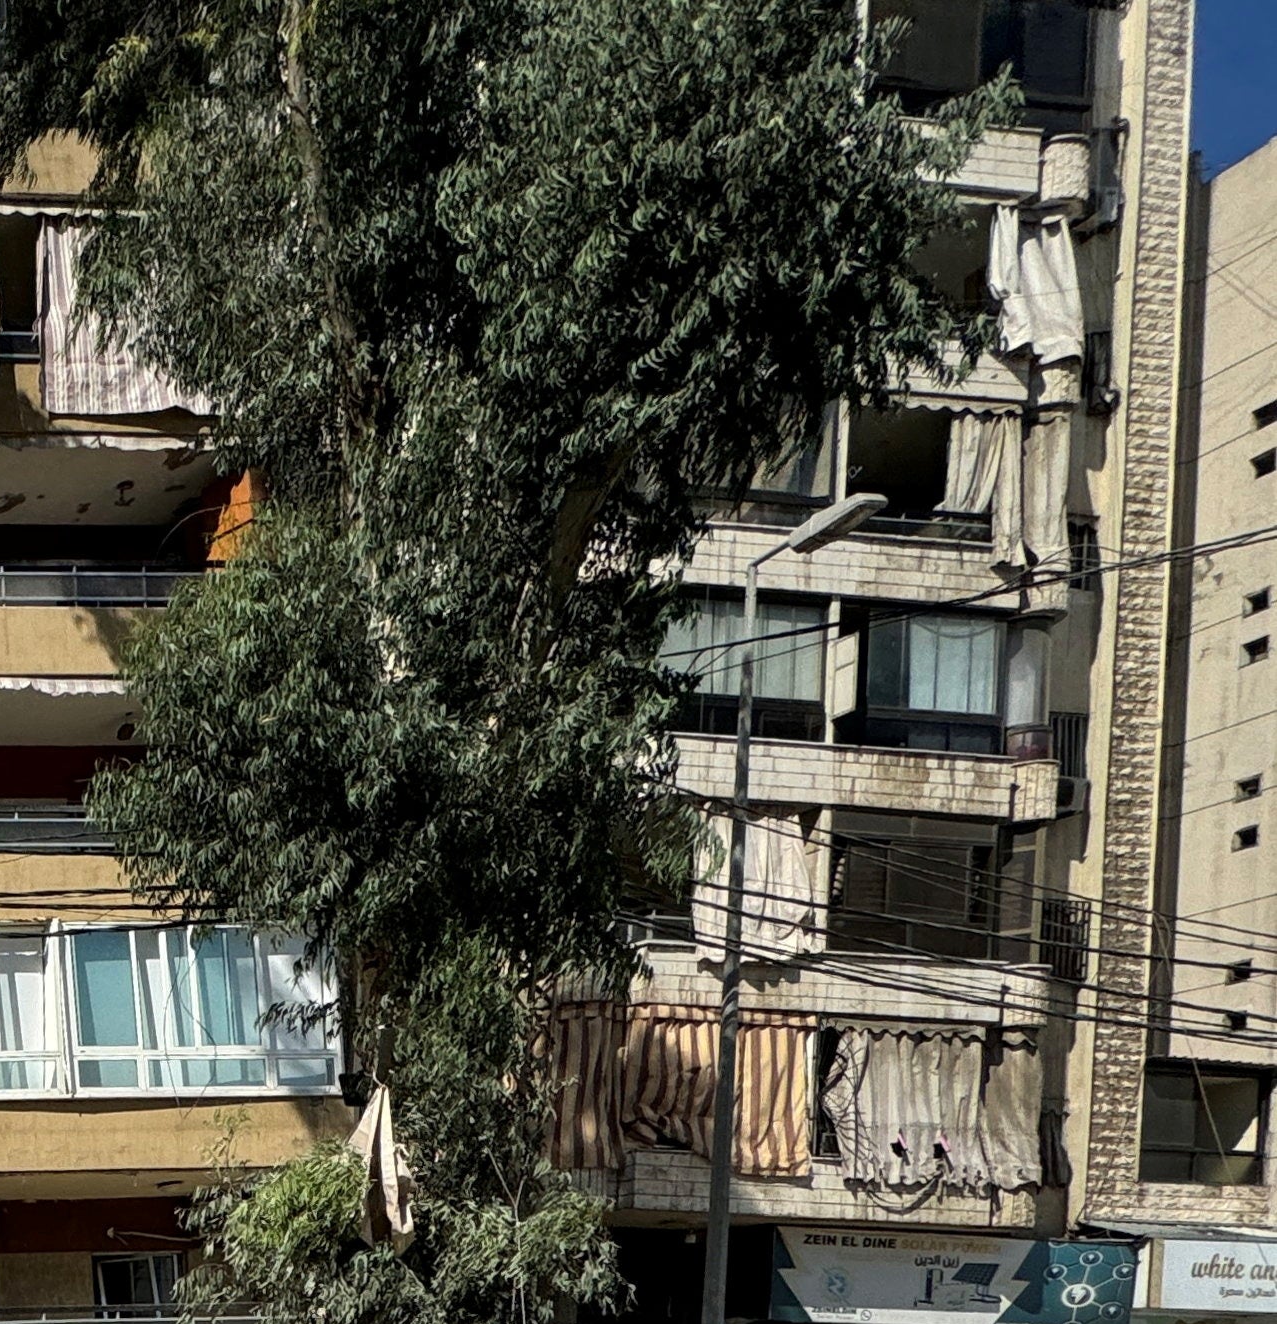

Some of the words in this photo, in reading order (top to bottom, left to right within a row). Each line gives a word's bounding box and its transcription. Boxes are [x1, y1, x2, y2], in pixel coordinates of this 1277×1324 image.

[803, 1233, 837, 1246] ZEIN
[841, 1236, 858, 1247] EL
[862, 1237, 897, 1249] DINE
[900, 1239, 948, 1251] SOLAR
[951, 1241, 1001, 1254] POWER
[914, 1254, 941, 1267] الدين
[942, 1255, 960, 1269] زين
[1191, 1252, 1245, 1279] white
[1250, 1263, 1277, 1286] an
